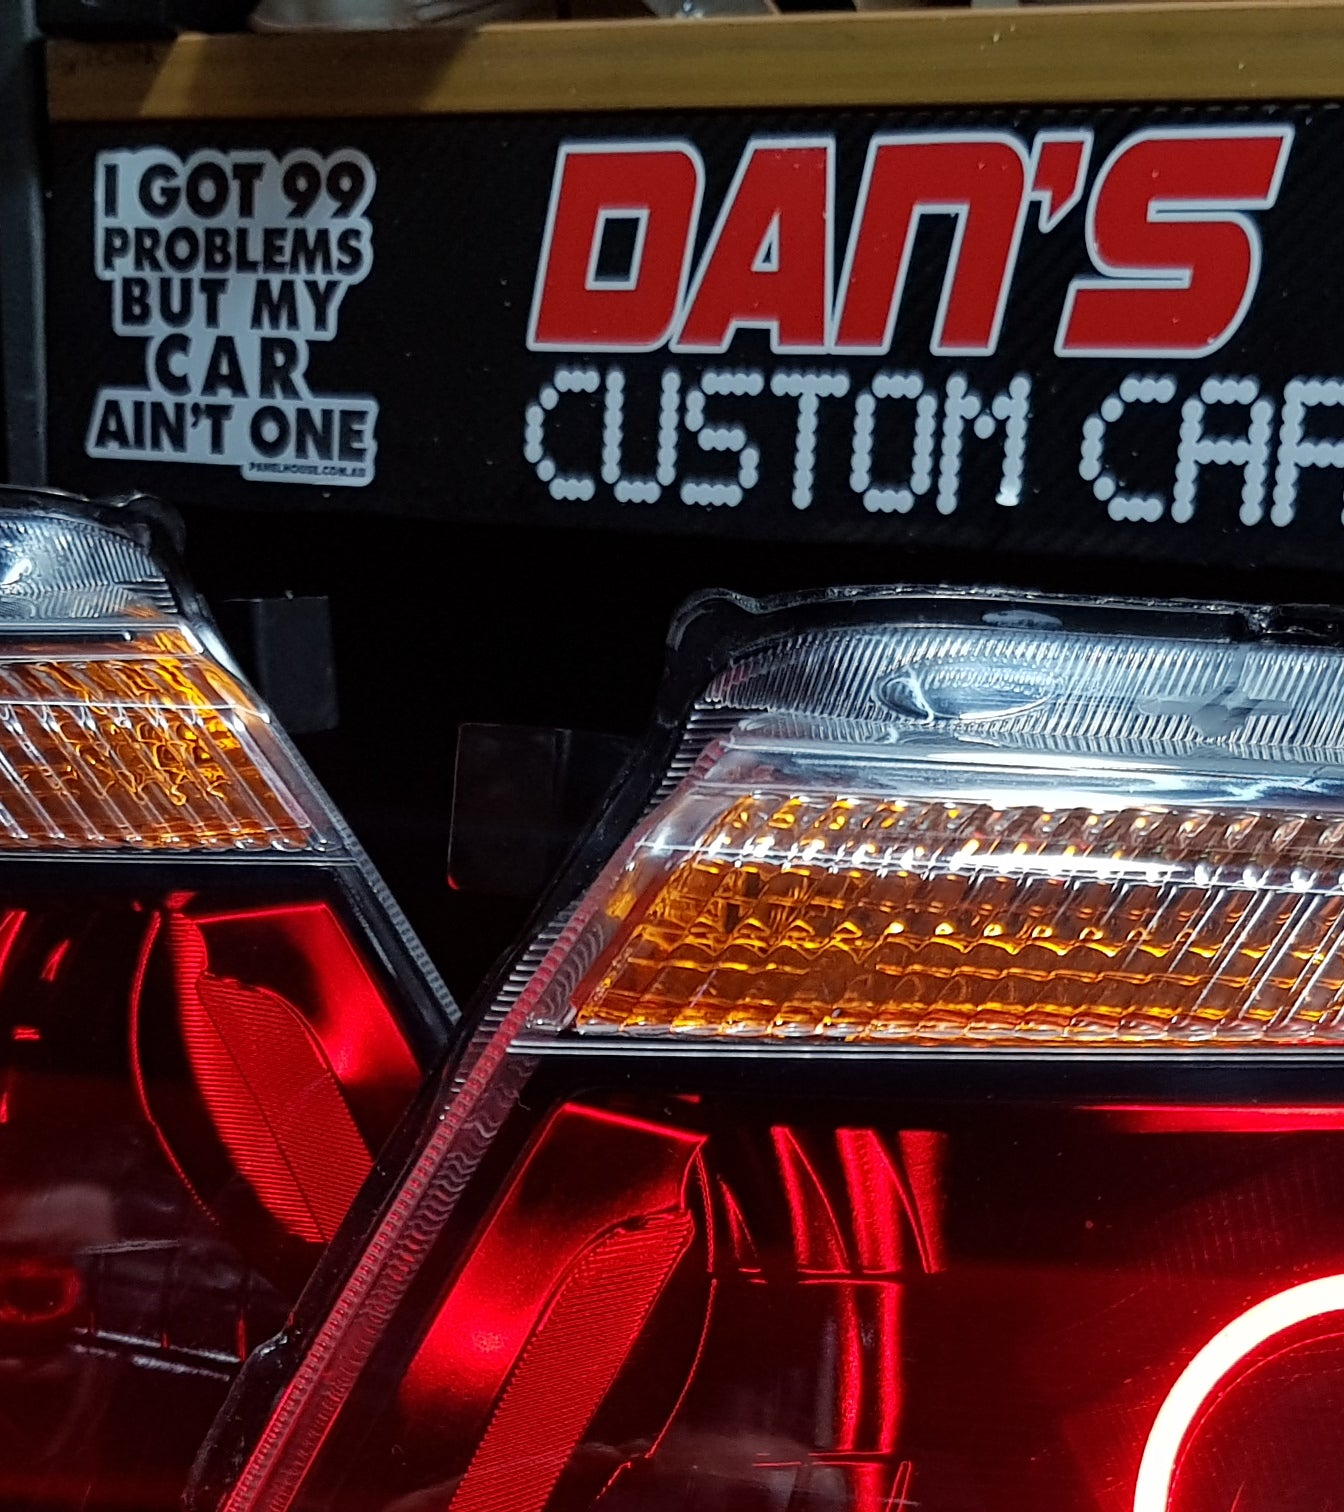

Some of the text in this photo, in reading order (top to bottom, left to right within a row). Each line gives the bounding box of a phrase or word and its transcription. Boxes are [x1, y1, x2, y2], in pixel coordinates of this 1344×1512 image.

[104, 160, 365, 219] I GOT 99
[104, 226, 364, 276] PROBLEMS
[526, 123, 1296, 359] DAN'S
[122, 276, 344, 332] BUT MY
[156, 333, 305, 400] CAR
[95, 399, 370, 462] AIN'T ONE
[524, 368, 1031, 515] CUSTOM
